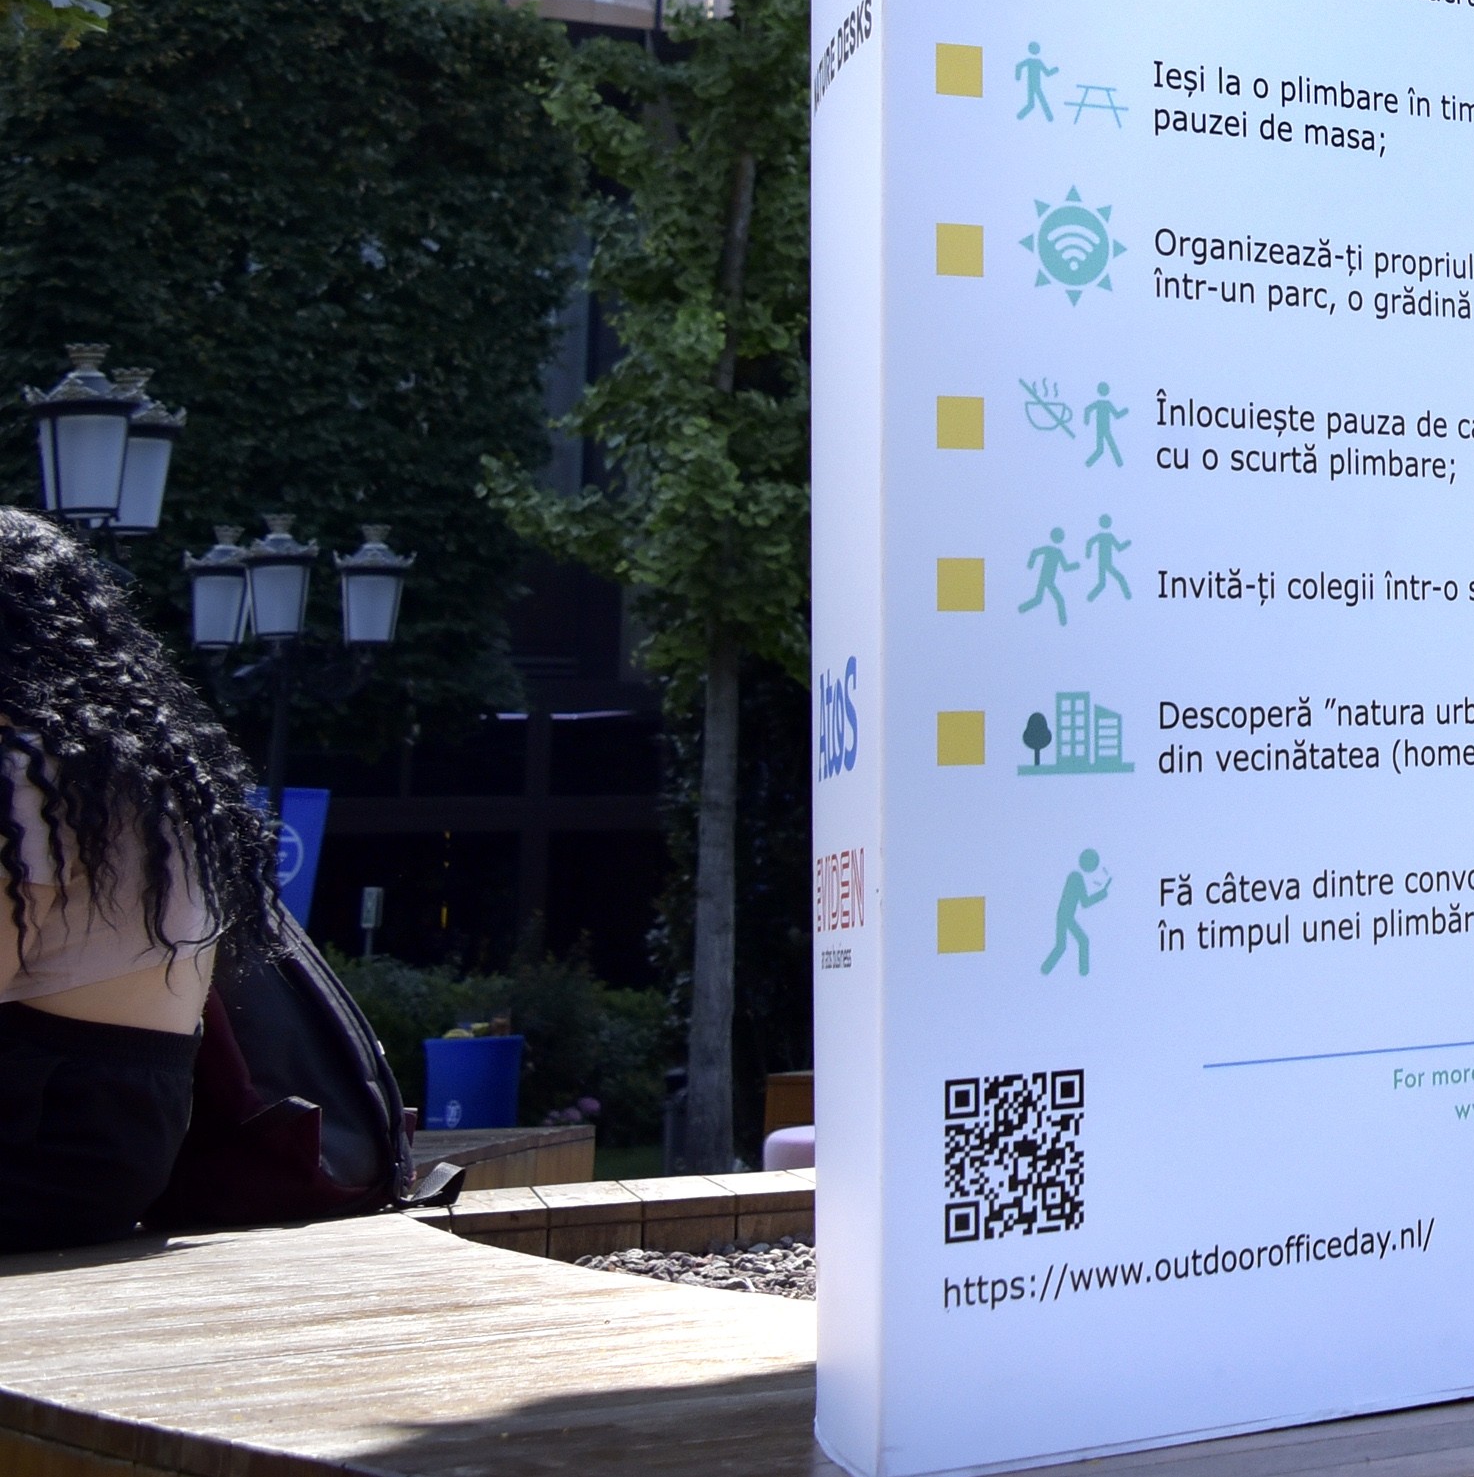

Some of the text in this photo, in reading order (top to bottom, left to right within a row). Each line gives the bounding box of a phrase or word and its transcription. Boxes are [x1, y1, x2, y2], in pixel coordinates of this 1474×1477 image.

[1218, 65, 1241, 97] la
[1252, 77, 1269, 100] o
[1280, 74, 1399, 115] plimbare
[1407, 86, 1431, 118] în
[1154, 107, 1386, 159] pauzei de masa;
[1374, 251, 1474, 283] propriul
[1153, 266, 1255, 305] într-un
[1267, 283, 1336, 316] parc,
[1347, 289, 1364, 312] o
[1373, 285, 1471, 320] grădină
[1326, 411, 1406, 441] pauza
[1416, 409, 1448, 439] de
[1156, 442, 1456, 486] cu o scurtă plimbare;
[1287, 570, 1374, 608] colegii
[1383, 569, 1459, 602] într-o
[1159, 695, 1312, 736] Descoperă
[1158, 743, 1203, 775] din
[1215, 738, 1380, 773] vecinătatea
[816, 847, 865, 933] EVIDEN
[1160, 872, 1193, 908] Fă
[1205, 870, 1301, 905] câteva
[1312, 868, 1394, 900] dintre
[1157, 918, 1185, 953] în
[1196, 913, 1290, 955] timpul
[1302, 910, 1361, 944] unei
[1393, 1067, 1426, 1090] For
[943, 1216, 1435, 1311] https://www.outdoorofficeday.nl/
